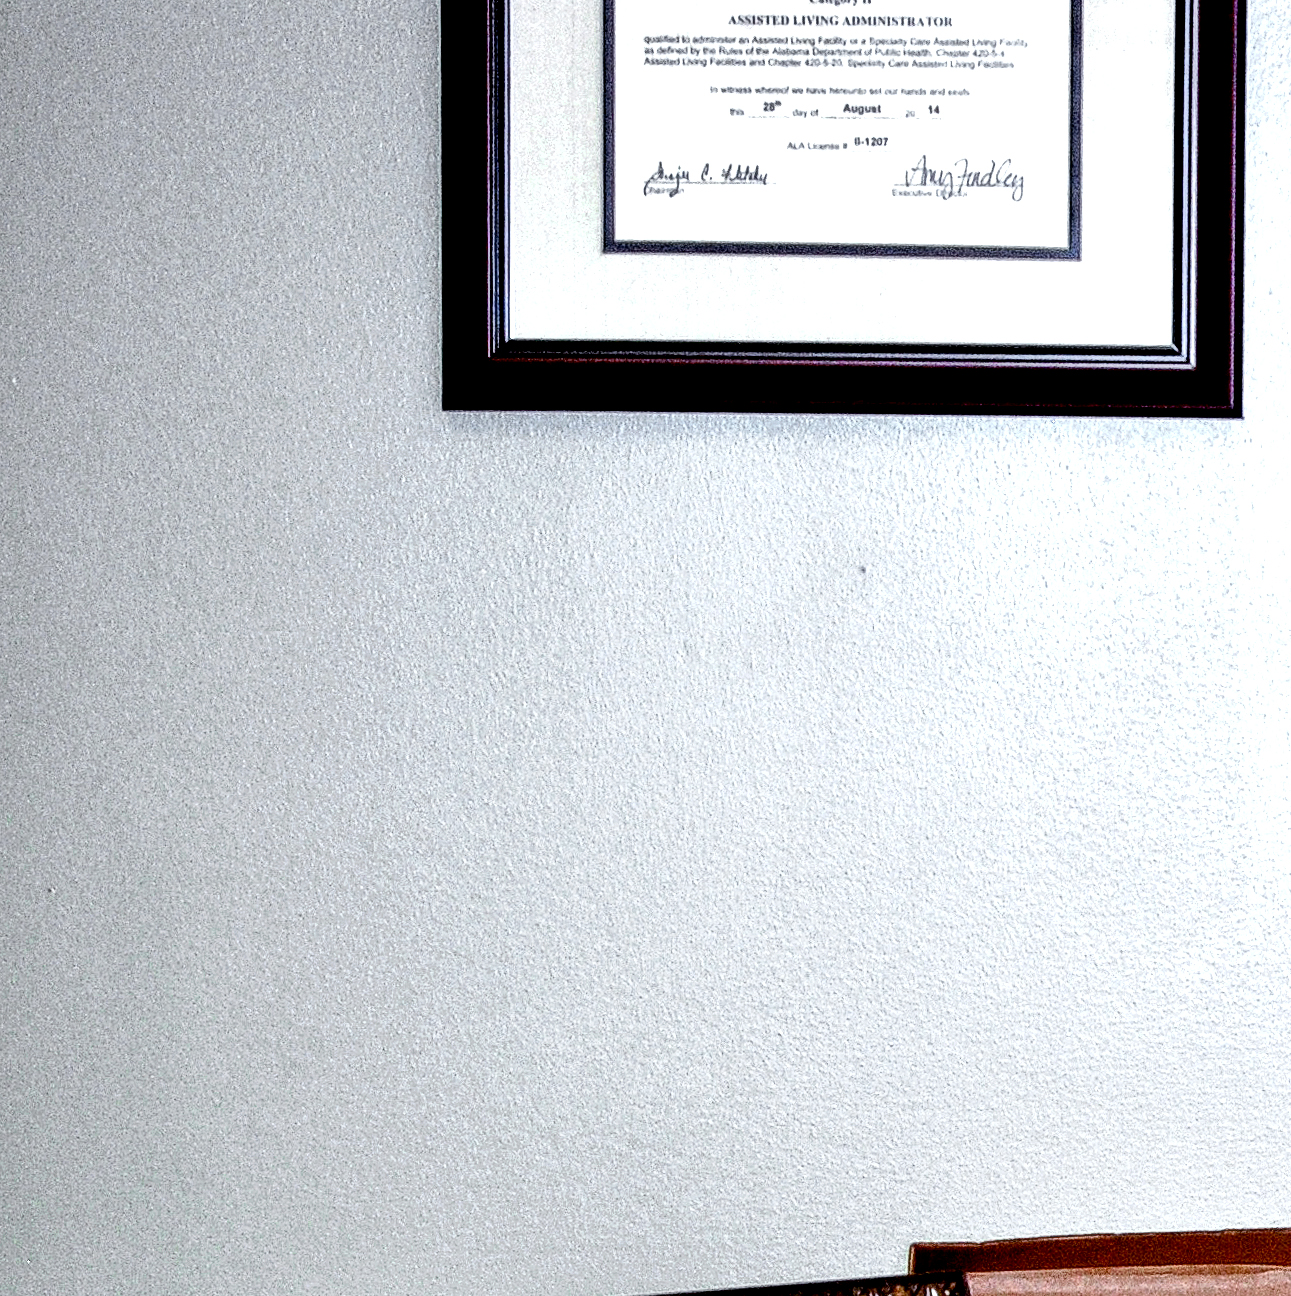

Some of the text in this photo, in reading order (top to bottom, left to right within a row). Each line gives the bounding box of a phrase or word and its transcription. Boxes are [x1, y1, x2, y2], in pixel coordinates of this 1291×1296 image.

[728, 15, 953, 27] ASSISTED LIVING ADMINISTRATOR
[730, 108, 745, 116] this
[793, 108, 807, 119] day
[810, 109, 819, 117] of
[843, 104, 882, 116] August
[928, 105, 940, 114] 14
